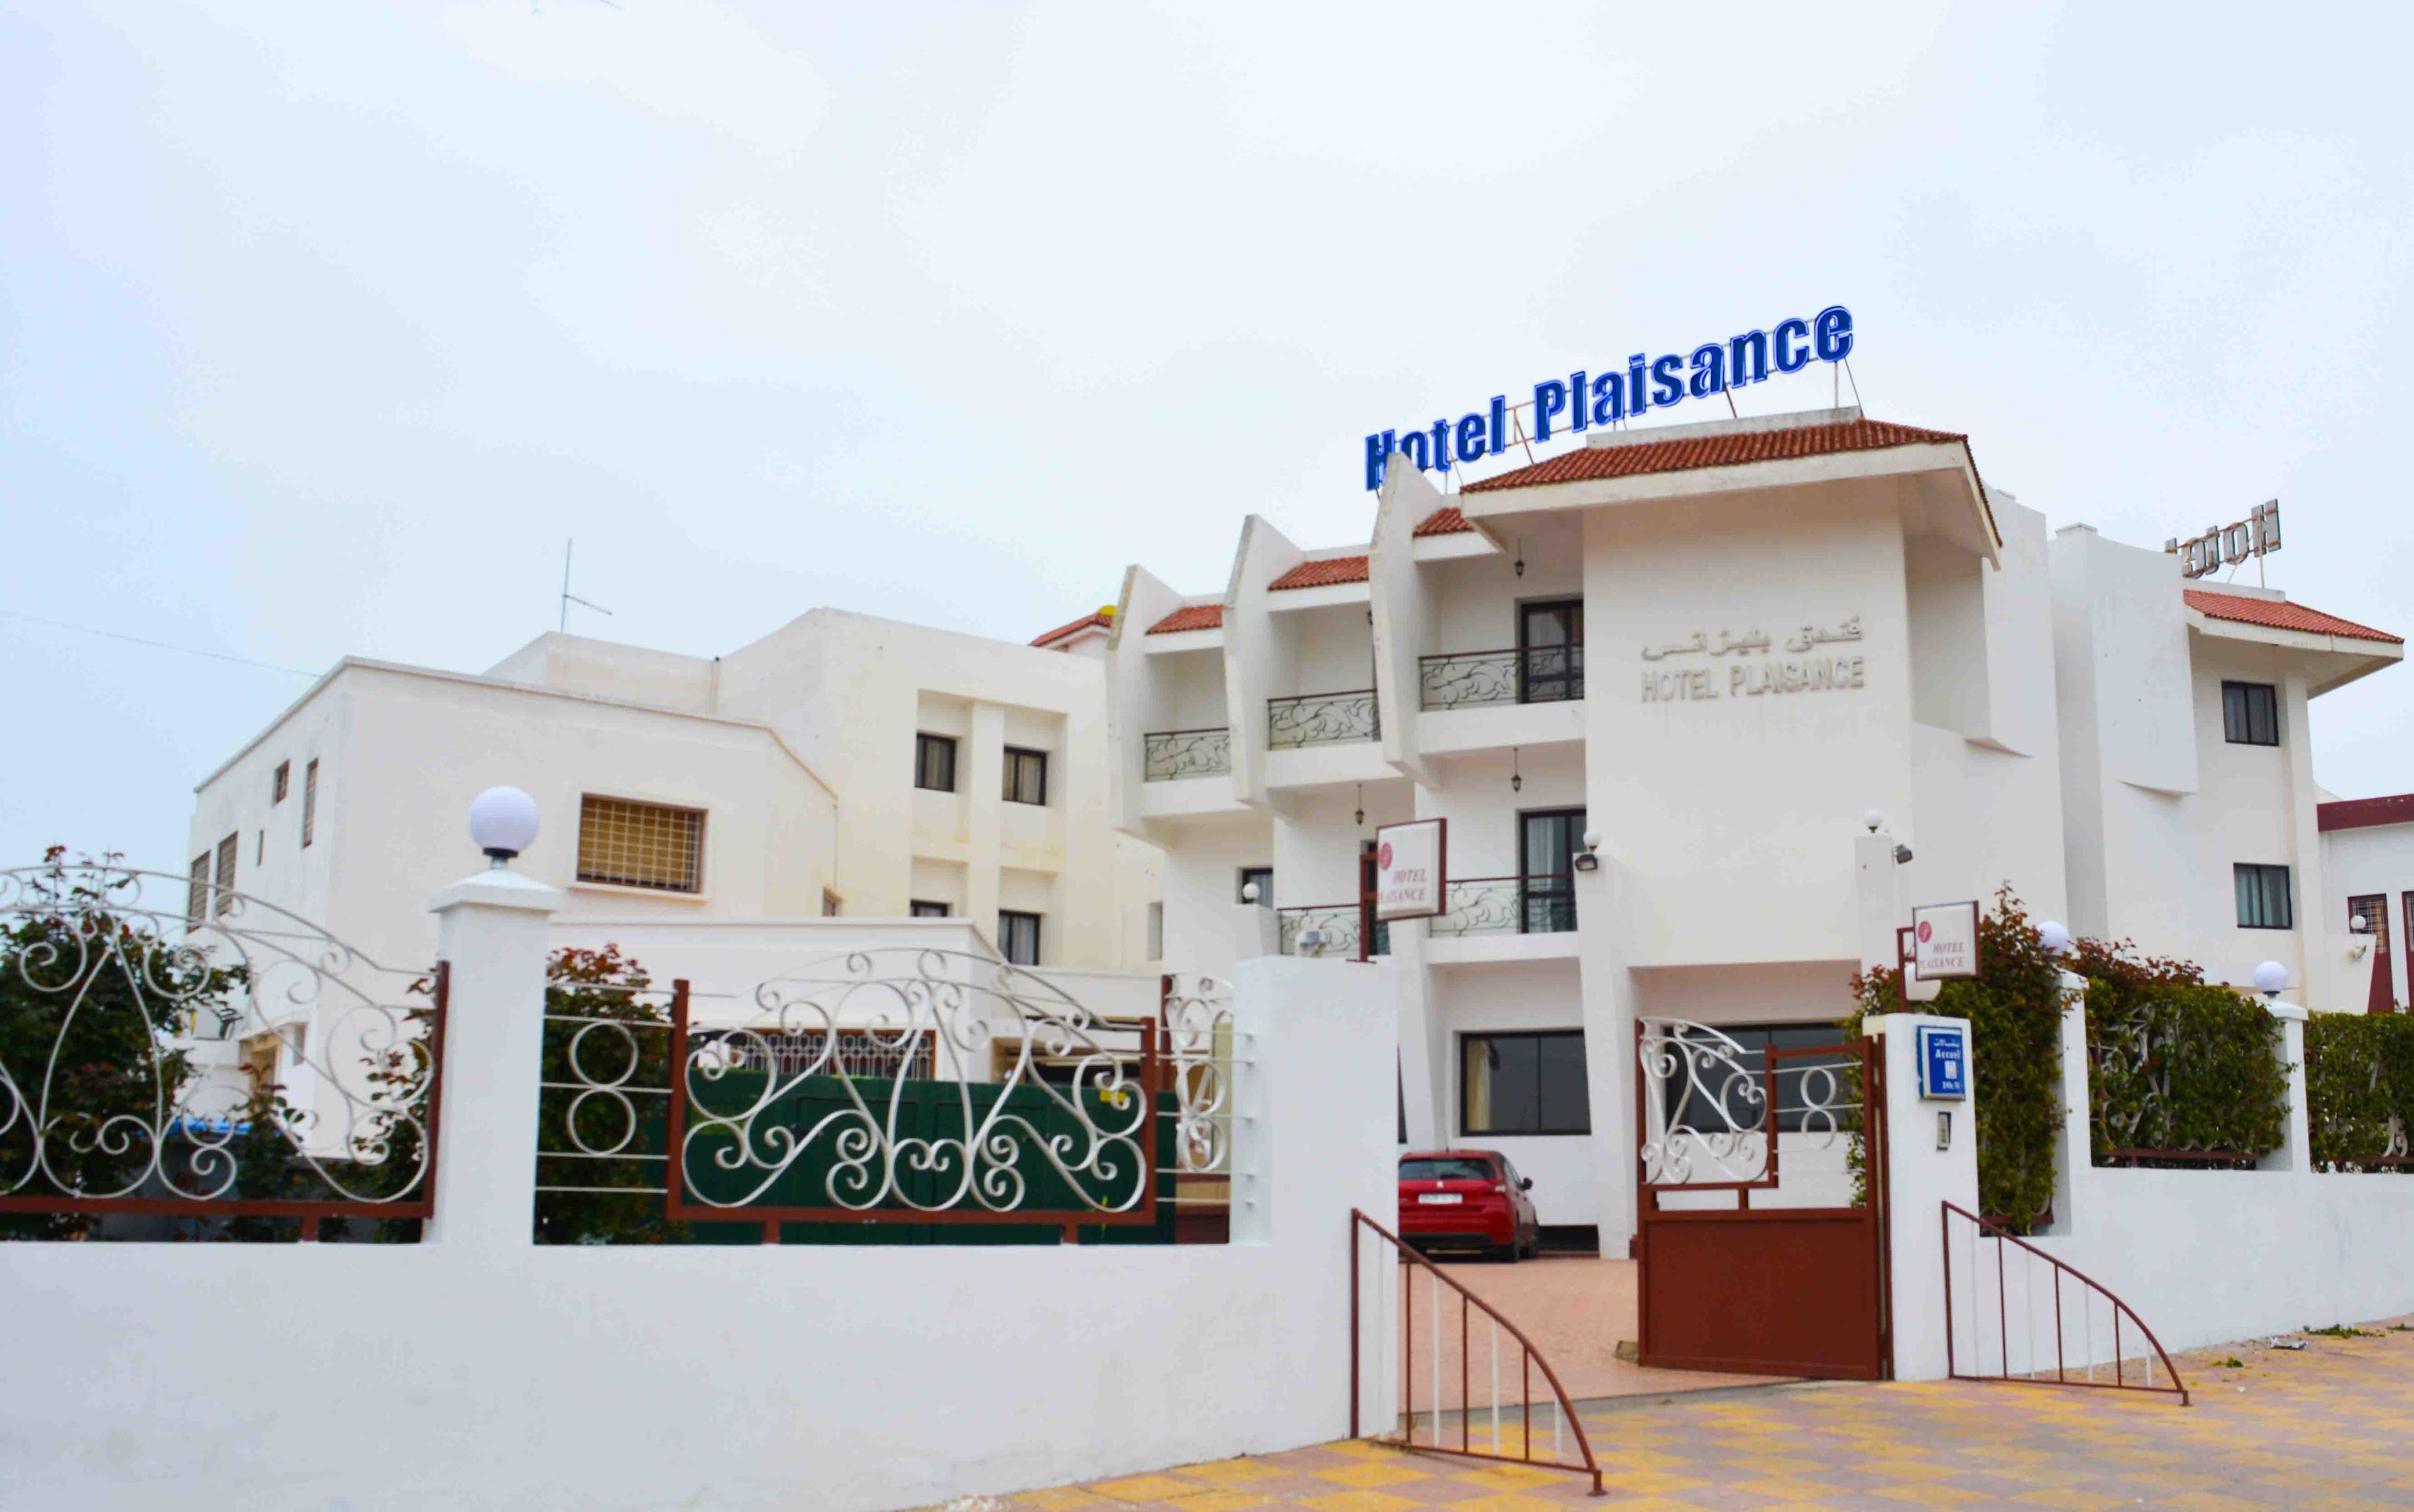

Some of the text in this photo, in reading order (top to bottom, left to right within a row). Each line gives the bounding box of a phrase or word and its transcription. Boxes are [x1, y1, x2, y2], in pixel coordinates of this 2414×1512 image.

[1365, 305, 1853, 491] Hotel Plaisance
[1641, 656, 1865, 703] HOTEL PLAISANCE
[1393, 869, 1427, 883] HOTEL
[1933, 942, 1964, 954] HOTEL
